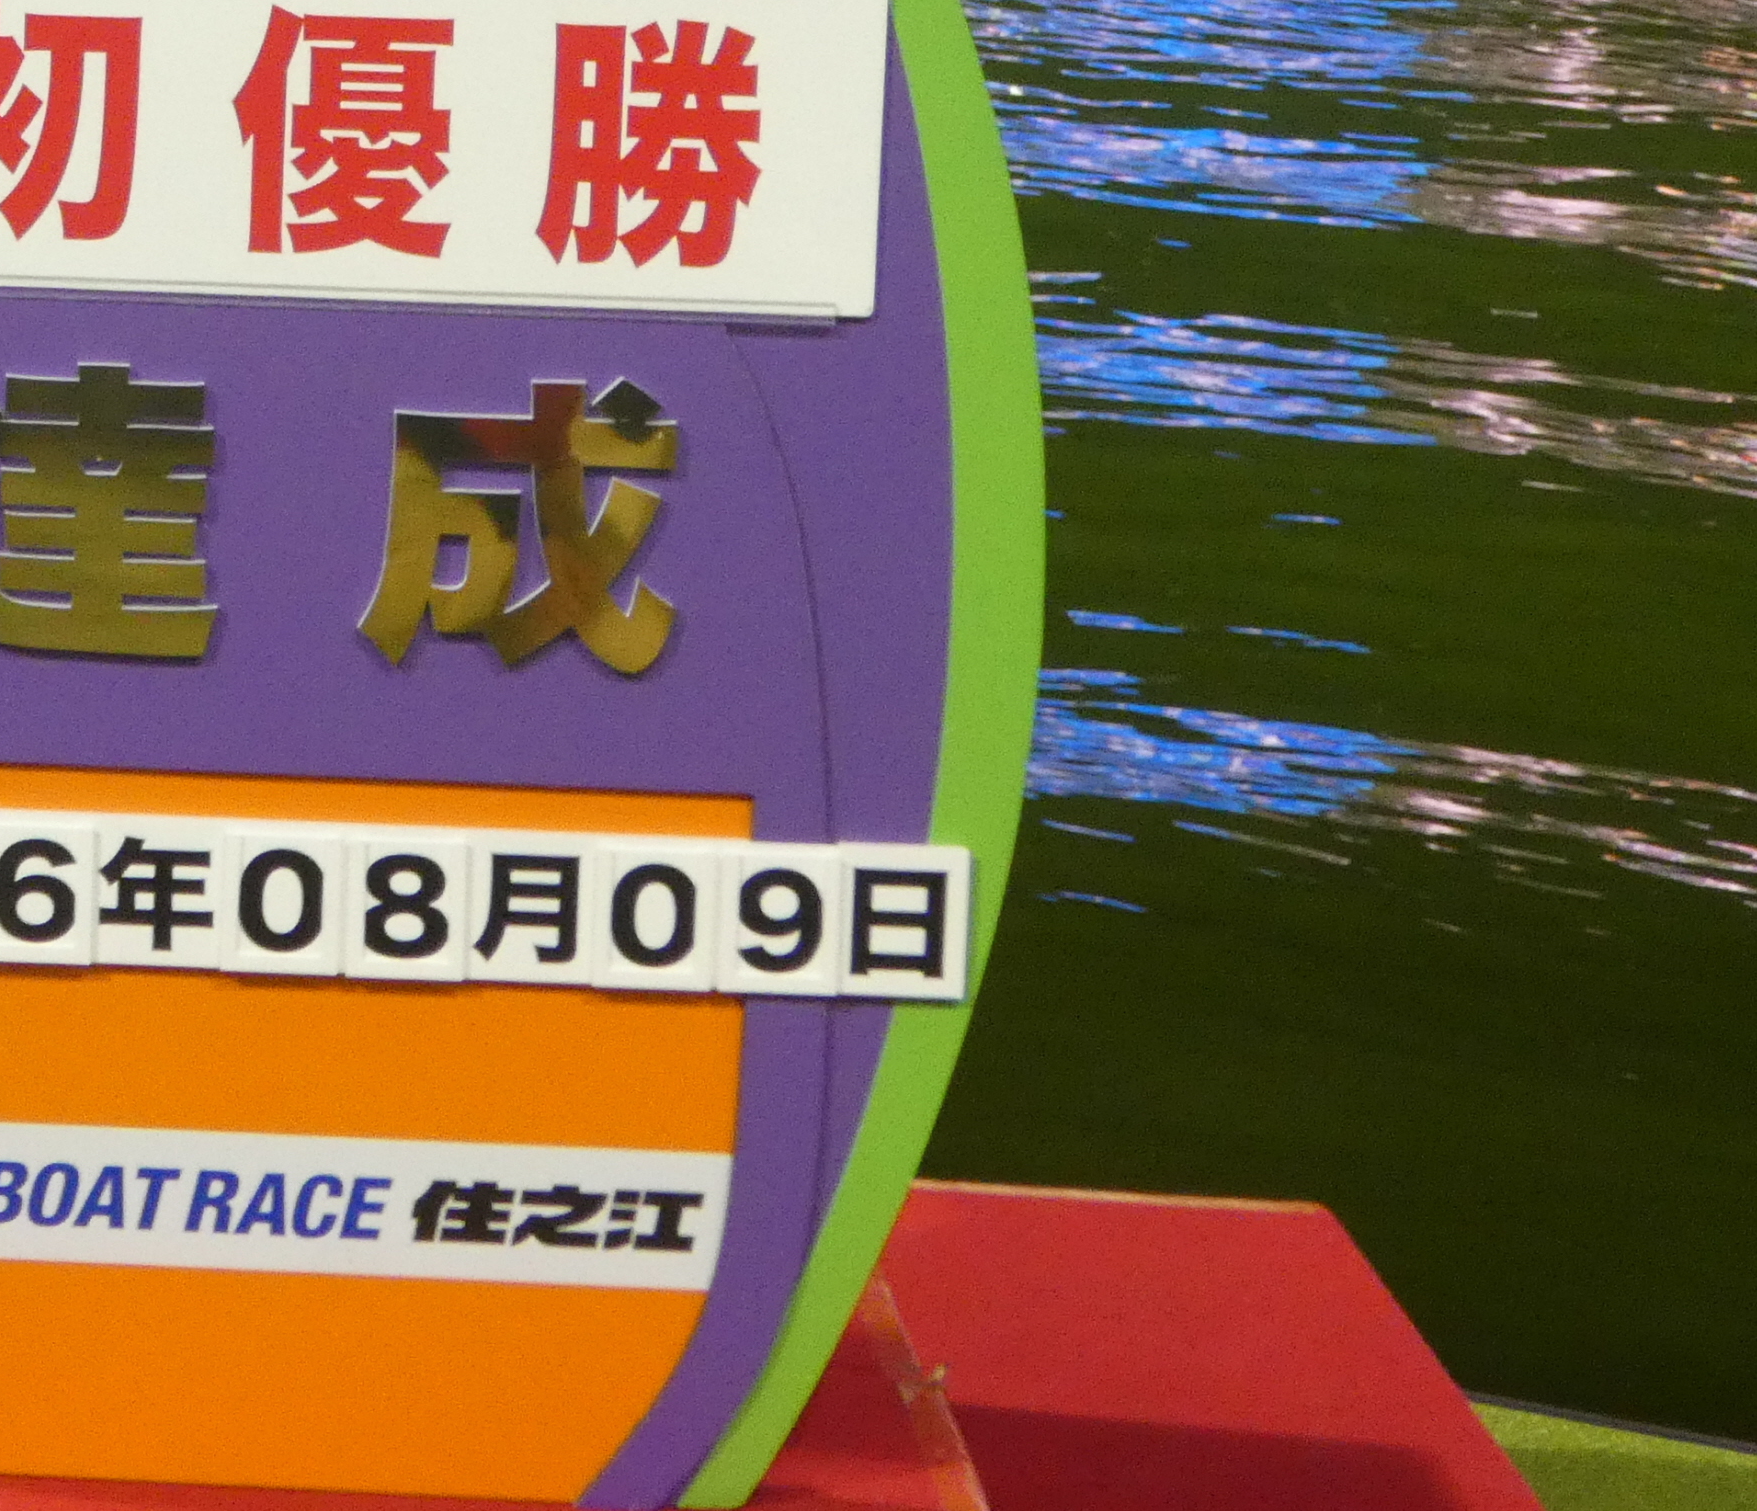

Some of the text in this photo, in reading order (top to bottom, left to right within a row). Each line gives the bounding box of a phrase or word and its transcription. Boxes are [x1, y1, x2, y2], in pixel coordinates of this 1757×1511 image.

[184, 1166, 394, 1242] RACE
[407, 1178, 707, 1254] 住之江
